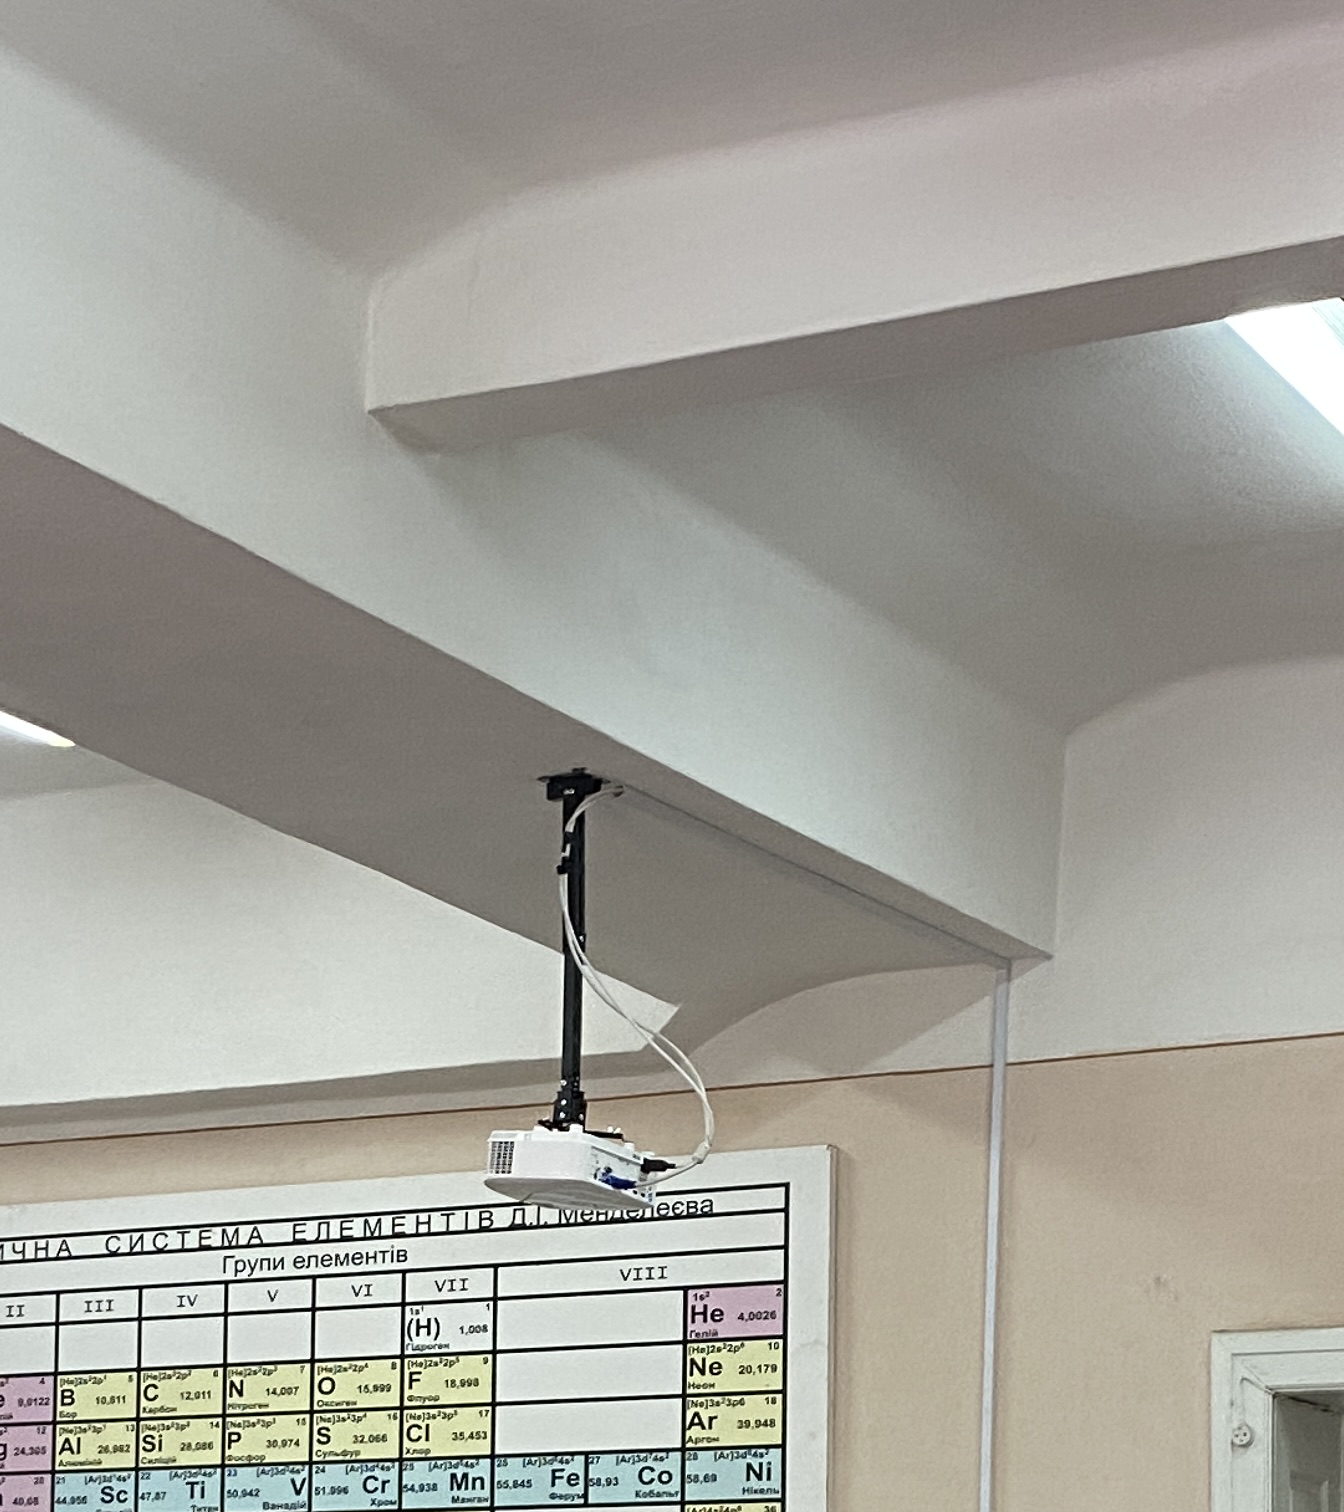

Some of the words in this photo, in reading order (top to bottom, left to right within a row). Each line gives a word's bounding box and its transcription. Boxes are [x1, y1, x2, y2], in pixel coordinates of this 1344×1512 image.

[105, 1226, 264, 1254] СИСТЕМА
[292, 1210, 495, 1243] ЕЛЕМЕНТІВ
[222, 1255, 285, 1278] Групи
[293, 1245, 408, 1272] елементів
[619, 1266, 668, 1282] VIII
[351, 1284, 373, 1298] VI
[434, 1278, 469, 1293] VII
[176, 1294, 198, 1308] IV
[267, 1290, 278, 1302] V
[6, 1304, 25, 1318] II
[84, 1299, 114, 1313] III
[691, 1304, 724, 1324] He
[407, 1317, 440, 1342] (H)
[689, 1357, 723, 1377] Ne
[229, 1379, 244, 1398] N
[317, 1376, 336, 1395] O
[408, 1371, 422, 1390] F
[60, 1388, 75, 1407] B
[143, 1383, 159, 1402] C
[686, 1412, 718, 1432] Ar
[142, 1434, 163, 1453] Si
[227, 1431, 242, 1450] P
[316, 1426, 331, 1445] S
[551, 1468, 580, 1488] Fe
[638, 1466, 673, 1485] Co
[746, 1461, 772, 1482] Ni
[185, 1480, 205, 1500] Ti
[290, 1477, 307, 1496] V
[362, 1475, 391, 1494] Cr
[450, 1472, 485, 1492] Mn
[100, 1485, 128, 1504] Sc
